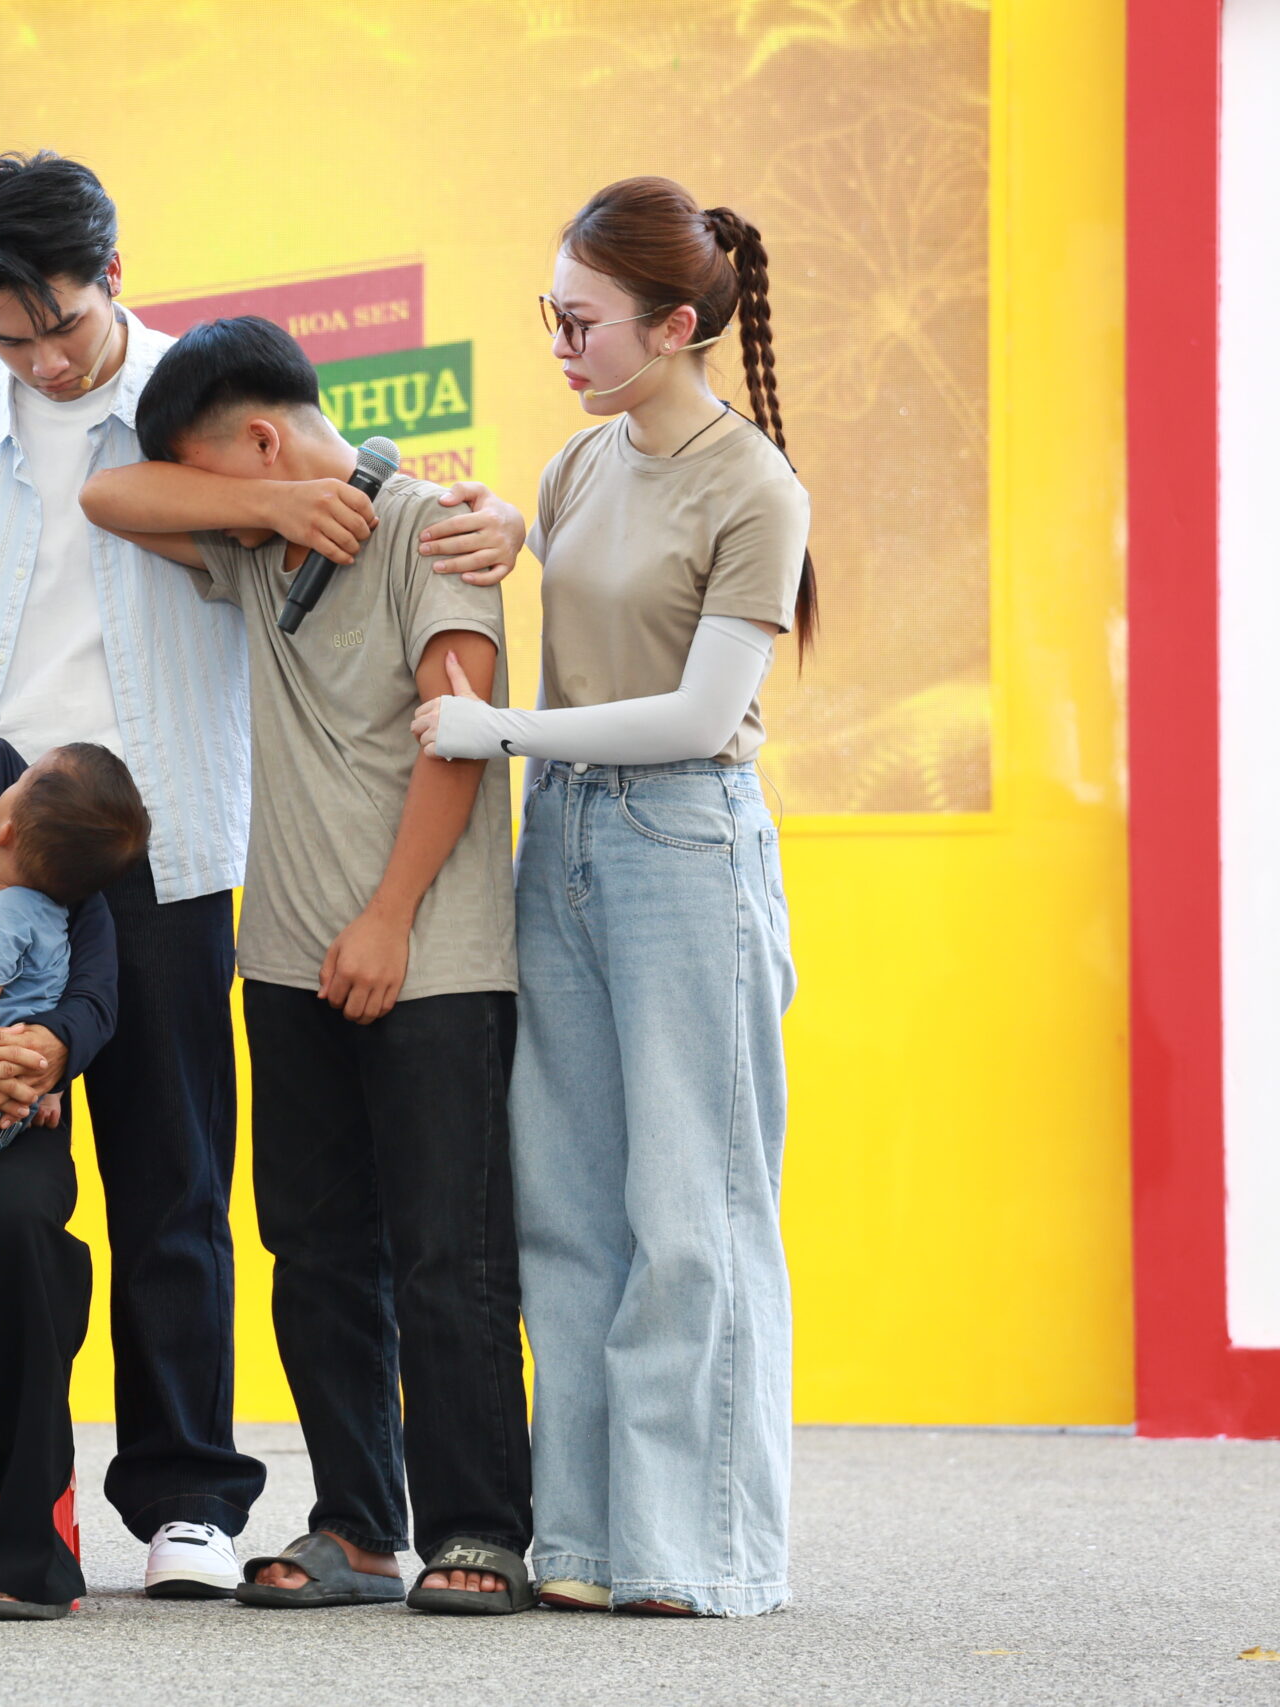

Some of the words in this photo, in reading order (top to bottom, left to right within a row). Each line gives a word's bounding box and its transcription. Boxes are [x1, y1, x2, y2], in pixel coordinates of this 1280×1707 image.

[288, 310, 349, 337] HOA
[353, 300, 410, 328] SEN
[319, 368, 469, 431] NHỤA
